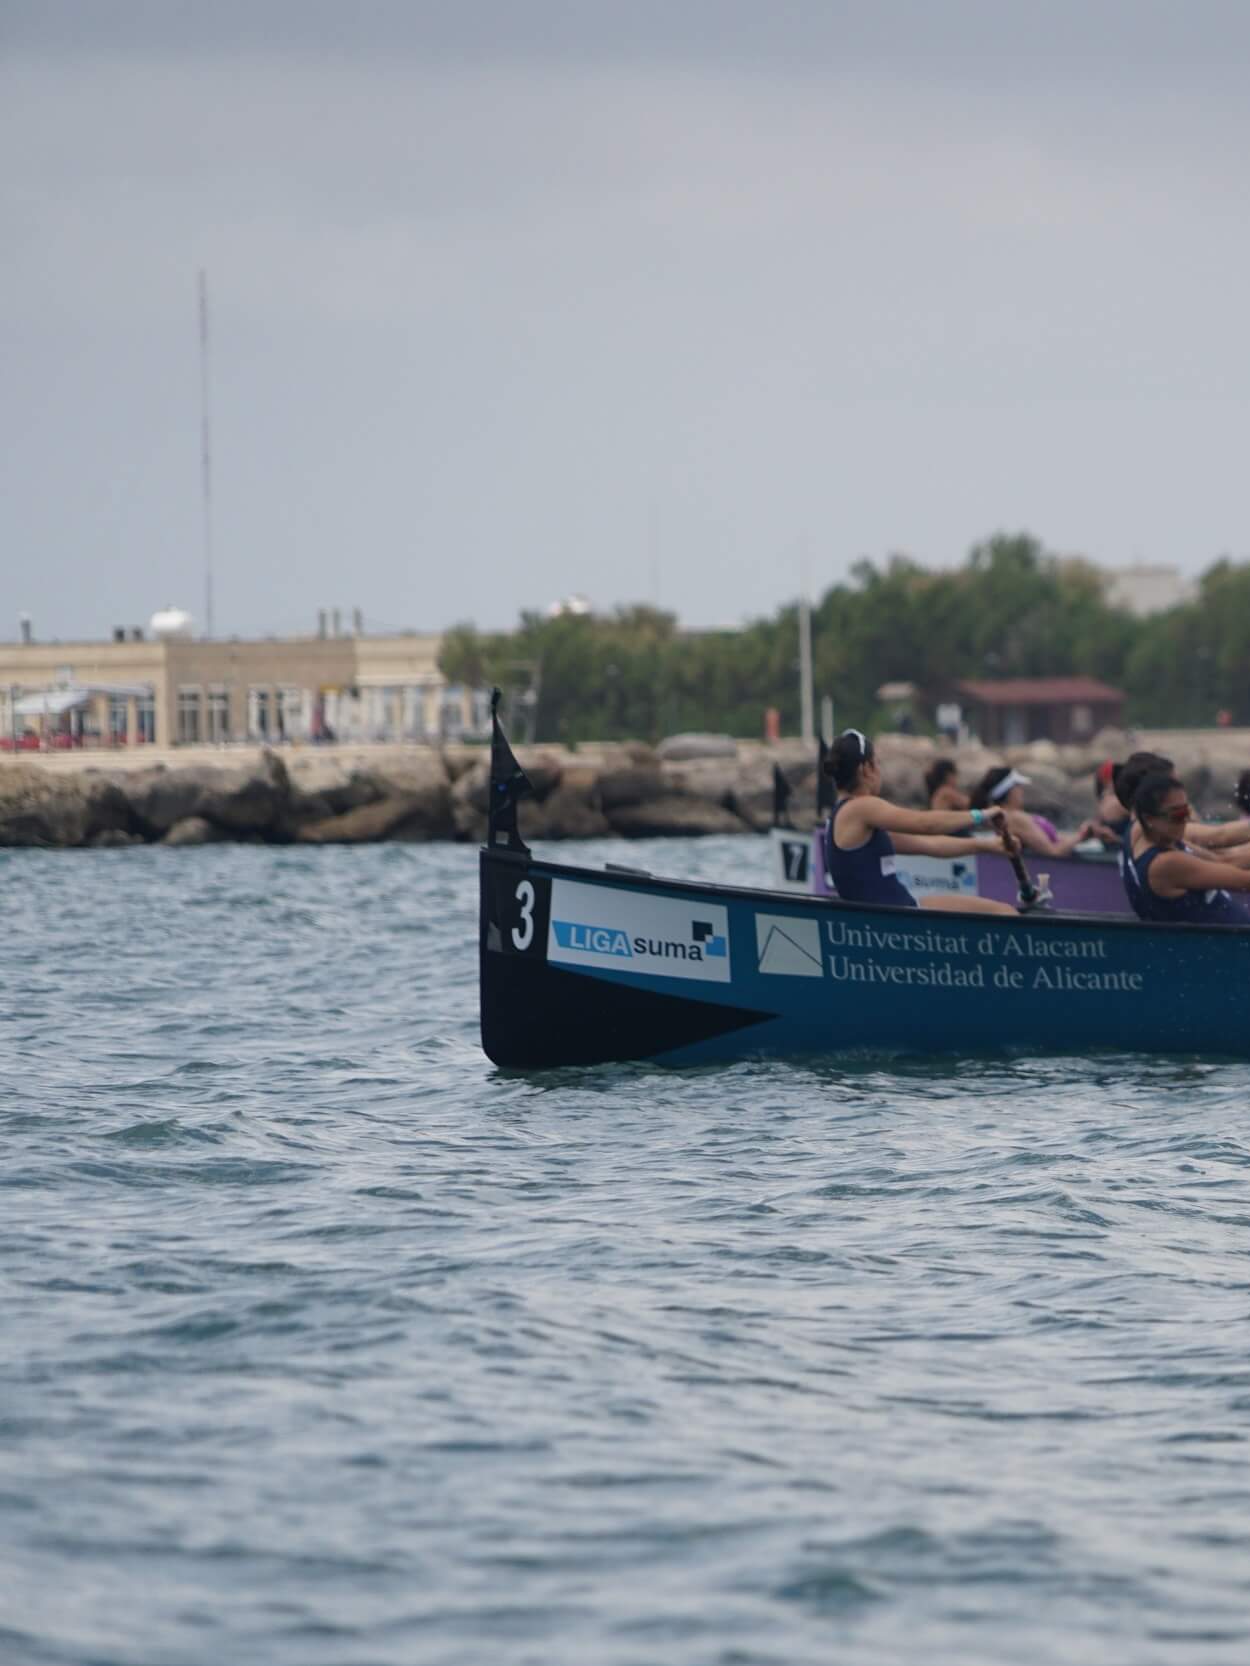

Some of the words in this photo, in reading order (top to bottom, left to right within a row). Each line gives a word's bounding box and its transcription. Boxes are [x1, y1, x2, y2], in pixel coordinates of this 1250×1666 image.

[511, 880, 535, 950] 3
[569, 926, 630, 955] LIGA
[633, 937, 704, 962] suma
[826, 920, 969, 955] Universitat
[977, 932, 1106, 958] d'Alacant
[828, 955, 985, 988] Universidad
[994, 966, 1023, 989] de
[1031, 967, 1144, 991] Alicante
